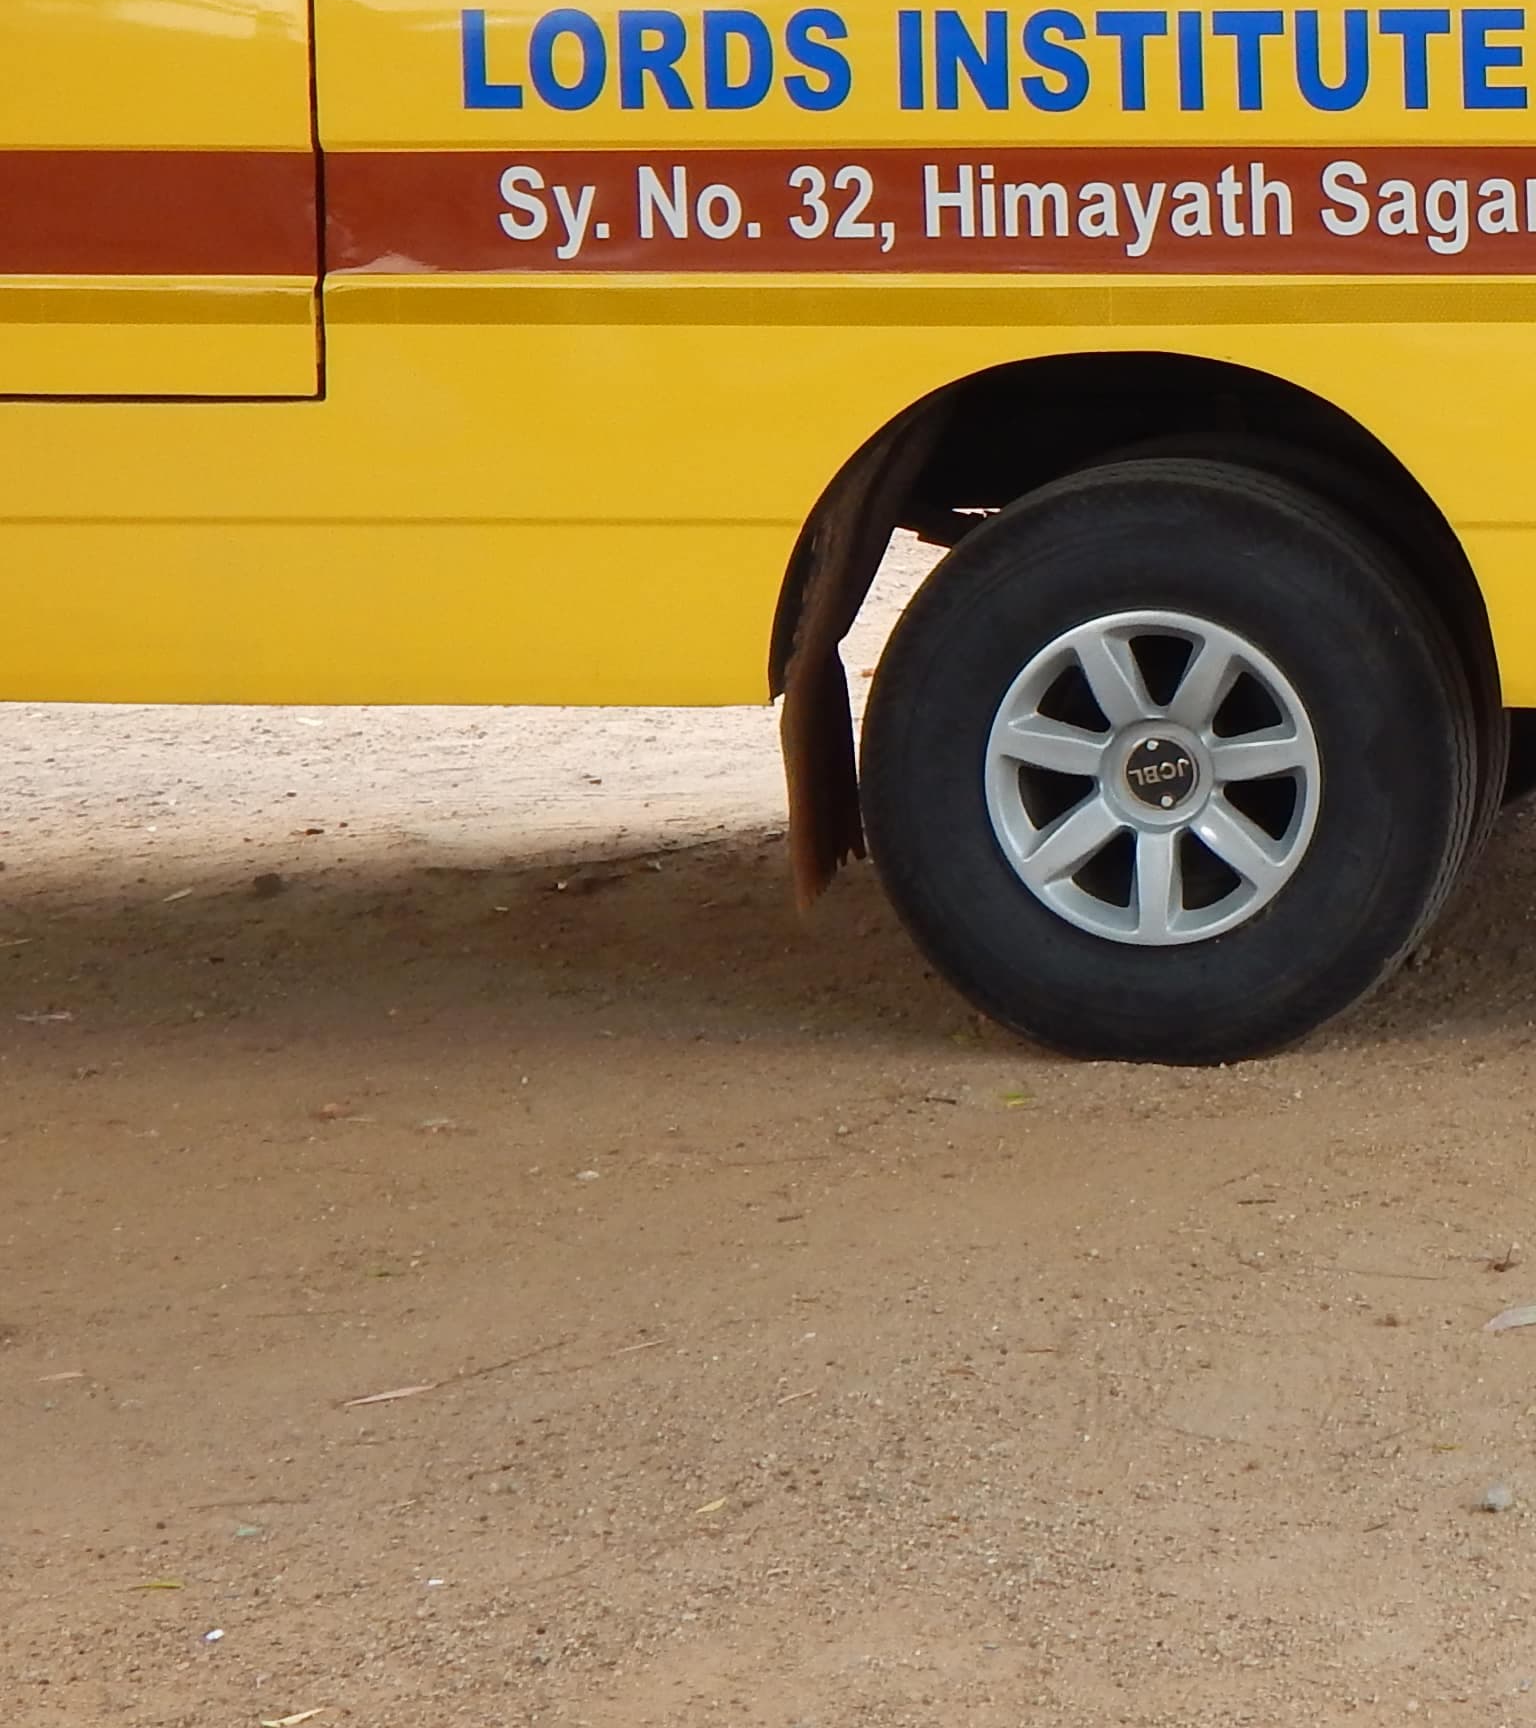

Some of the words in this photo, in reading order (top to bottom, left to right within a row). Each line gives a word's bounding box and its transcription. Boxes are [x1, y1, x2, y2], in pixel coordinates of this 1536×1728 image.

[464, 8, 851, 111] LORDS
[899, 9, 1527, 112] INSTITUTE
[499, 164, 609, 260] Sy.
[638, 165, 761, 240] No.
[788, 165, 895, 253] 32,
[924, 162, 1293, 257] Himayath
[1127, 758, 1190, 786] JCBL
